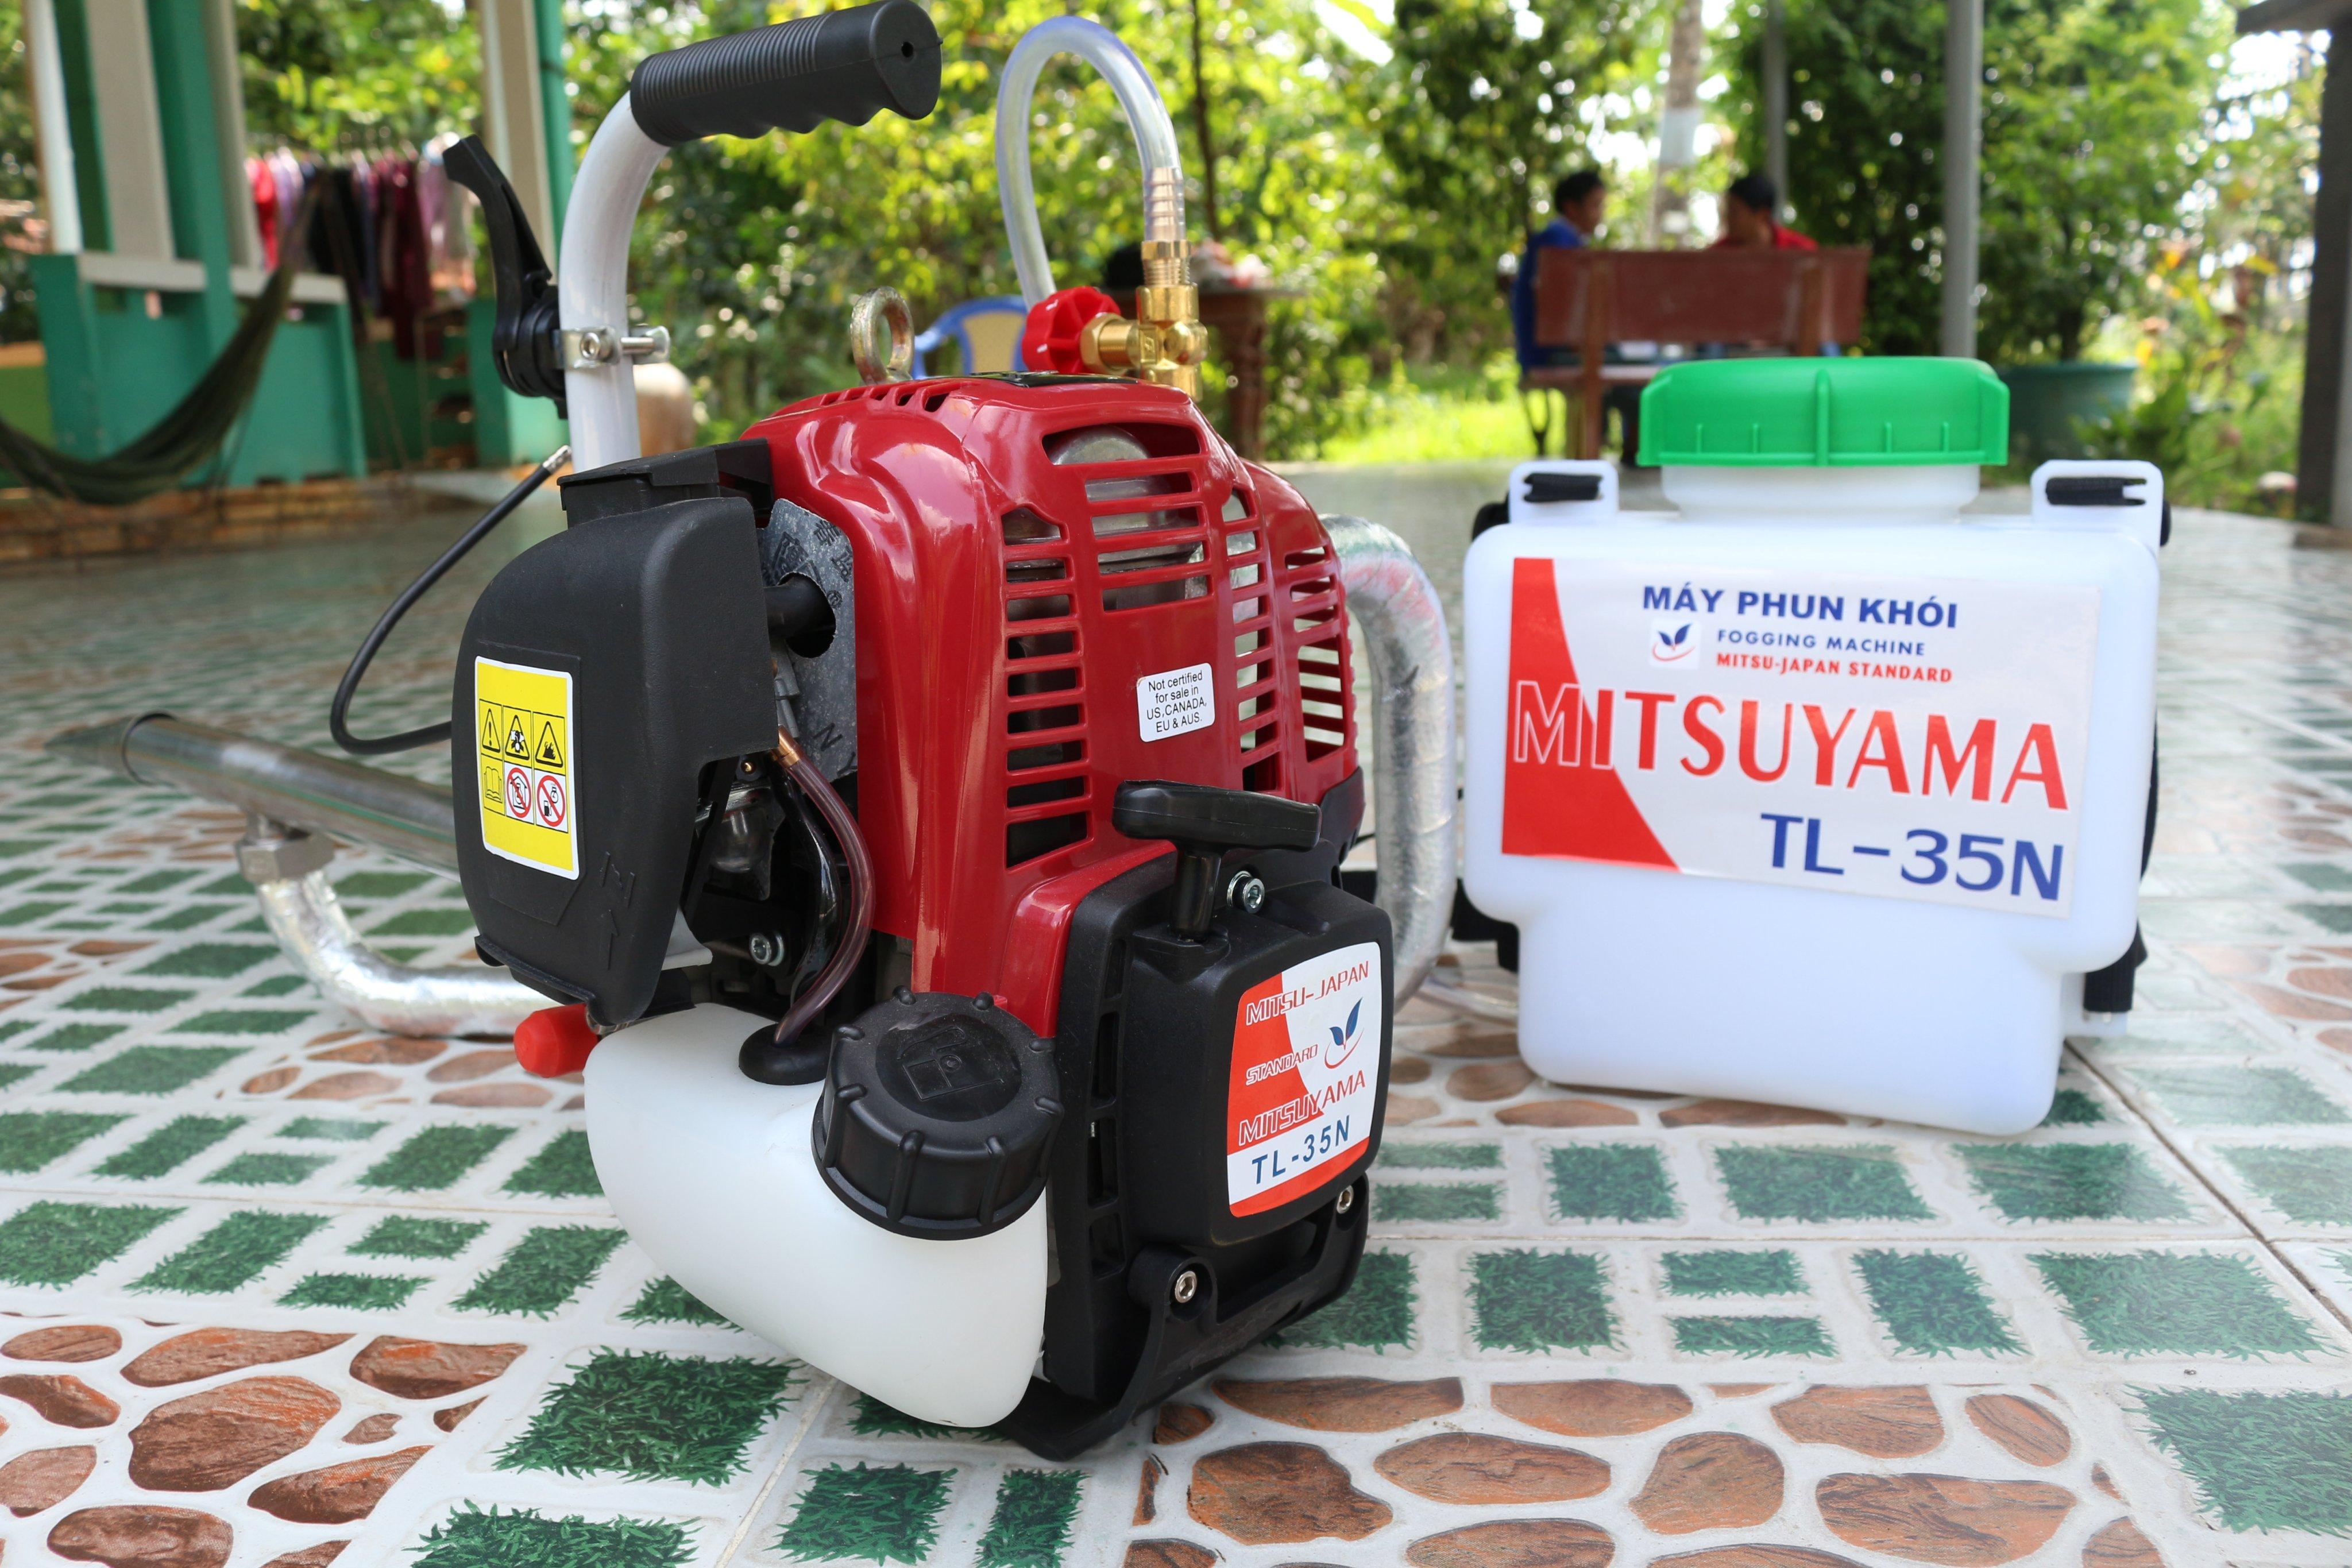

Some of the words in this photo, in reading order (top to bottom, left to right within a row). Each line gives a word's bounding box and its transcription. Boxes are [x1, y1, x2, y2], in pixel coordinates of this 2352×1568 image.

[1642, 582, 1724, 613] MÁY
[1737, 591, 1844, 621] PHUN
[1859, 596, 1958, 629] KHÓI
[1718, 629, 1816, 648] FOGGING
[1826, 636, 1925, 656] MACHINE
[1148, 679, 1165, 692] Not
[1167, 670, 1203, 688] certified
[1716, 652, 1840, 675] MITSU-JAPAN
[1849, 662, 1953, 683] STANDARD
[1155, 693, 1168, 704] for
[1171, 688, 1189, 700] sale
[1191, 685, 1199, 696] in
[1156, 720, 1170, 732] EU
[1172, 717, 1179, 729] &
[1181, 712, 1203, 727] AUS.
[1513, 680, 2068, 810] MITSUYAMA
[1760, 812, 2064, 901] TL-35N
[1246, 960, 1369, 1026] MITSU-JAPAN
[1246, 1044, 1318, 1086] STANDARD
[1238, 1070, 1366, 1146] MITSUYAMA
[1252, 1115, 1350, 1184] TL-35N
